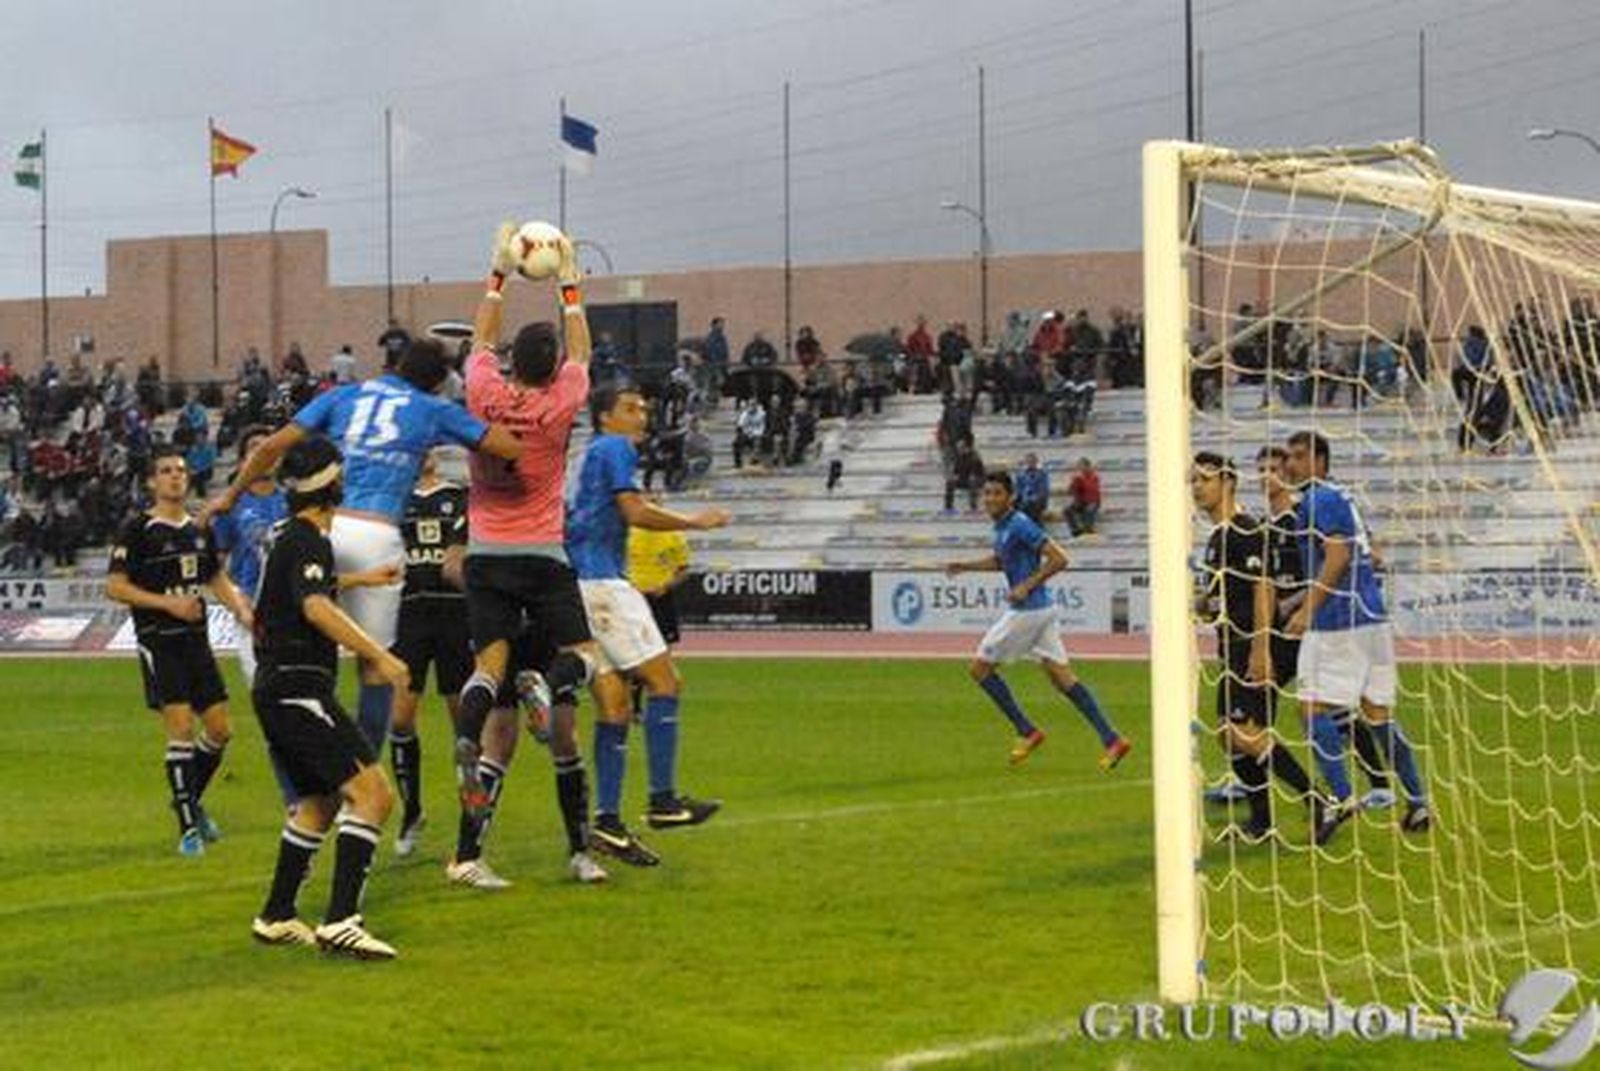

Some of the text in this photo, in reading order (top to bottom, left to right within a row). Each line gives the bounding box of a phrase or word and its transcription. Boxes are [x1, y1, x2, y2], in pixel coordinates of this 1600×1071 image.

[345, 394, 410, 445] 15
[702, 572, 817, 595] OFFICIUM
[932, 586, 987, 609] ISLA
